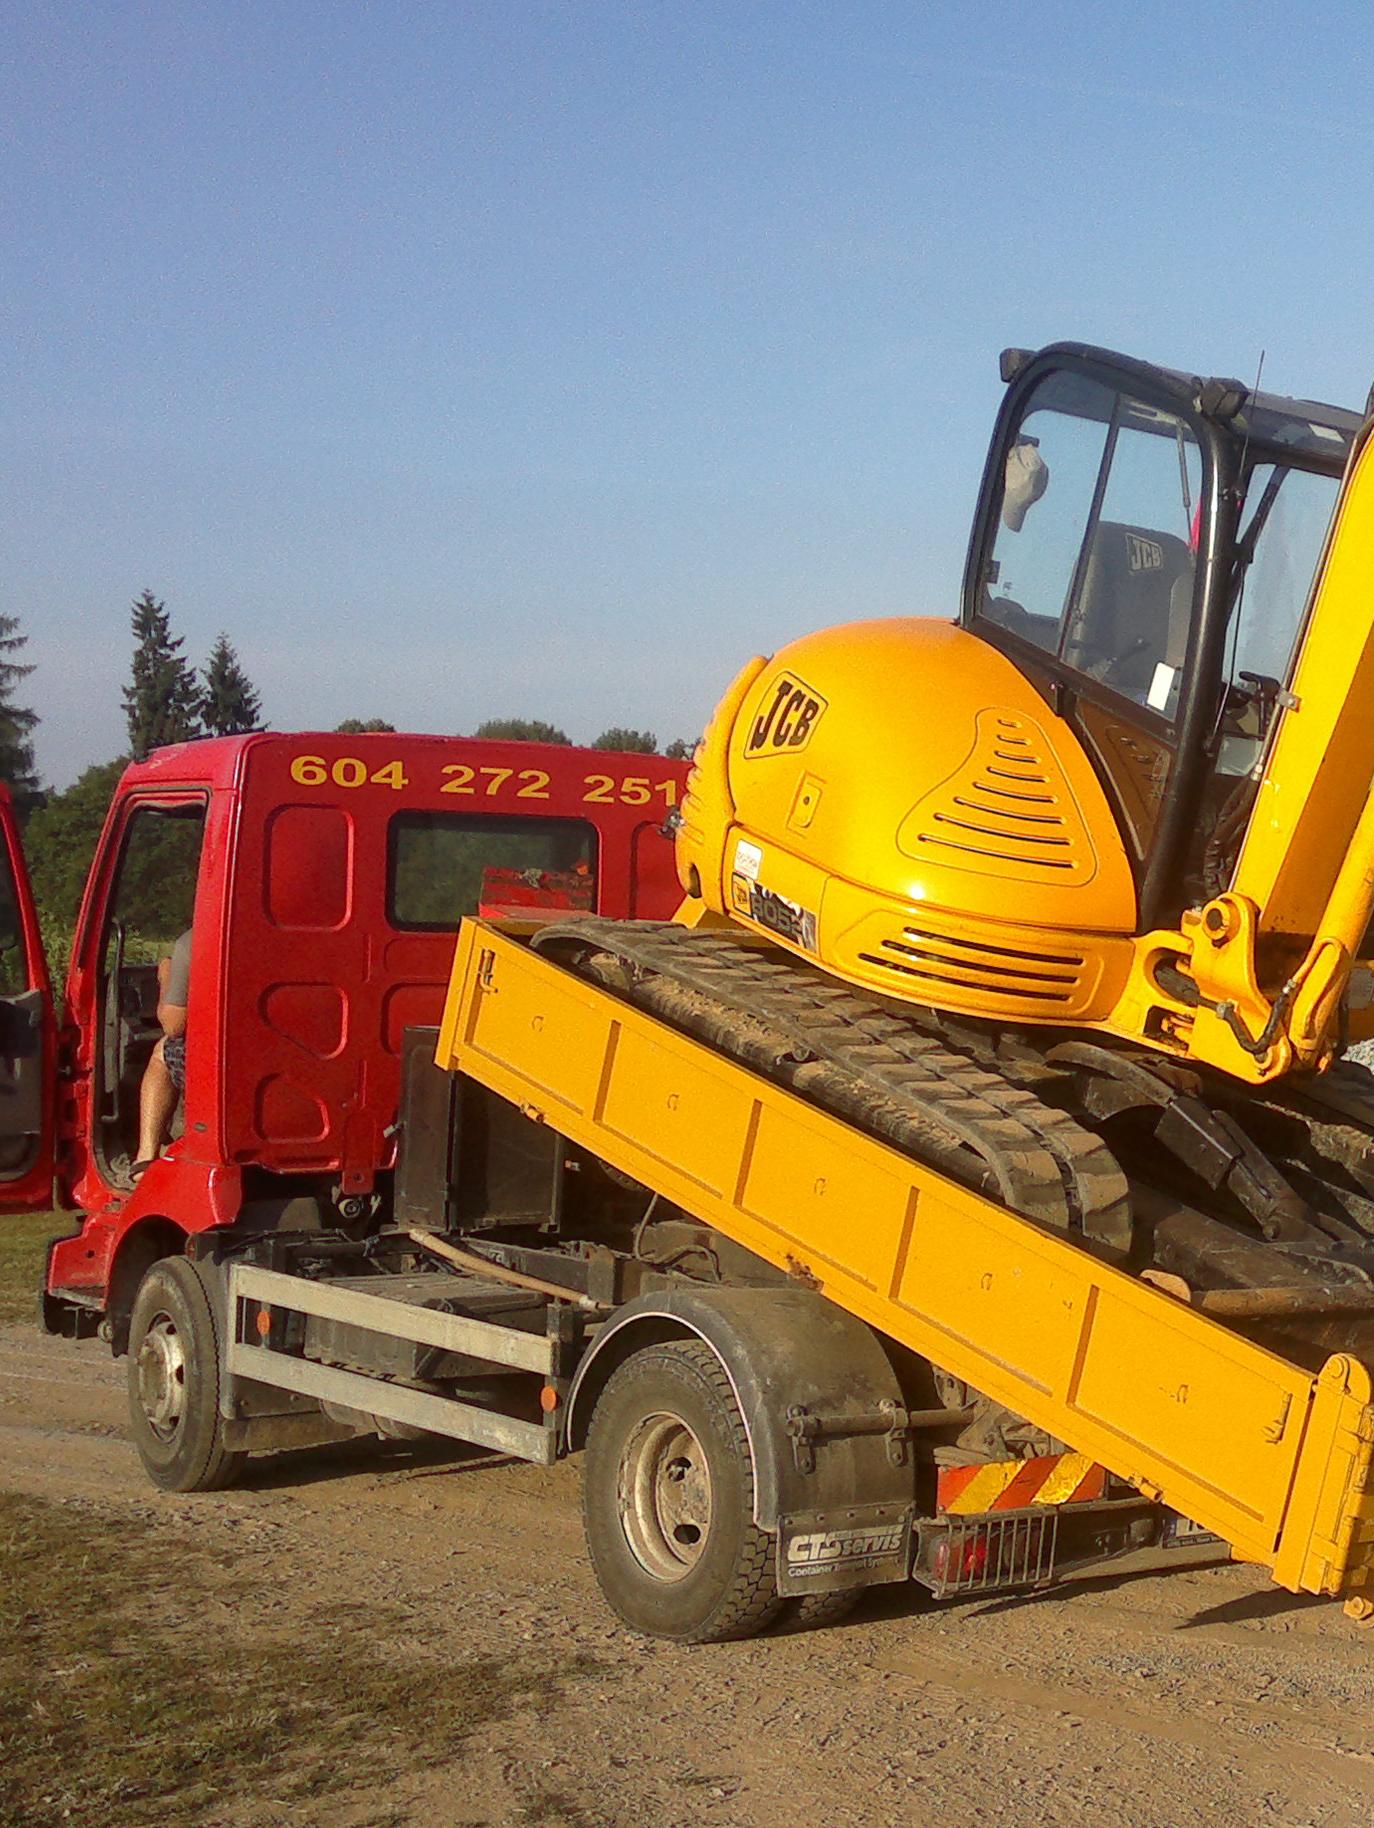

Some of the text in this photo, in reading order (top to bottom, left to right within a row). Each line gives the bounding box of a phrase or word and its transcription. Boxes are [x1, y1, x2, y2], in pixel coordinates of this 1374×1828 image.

[1131, 539, 1161, 570] JCB
[749, 680, 820, 751] JCB
[290, 755, 677, 807] 604 272 251
[842, 1533, 903, 1556] servis
